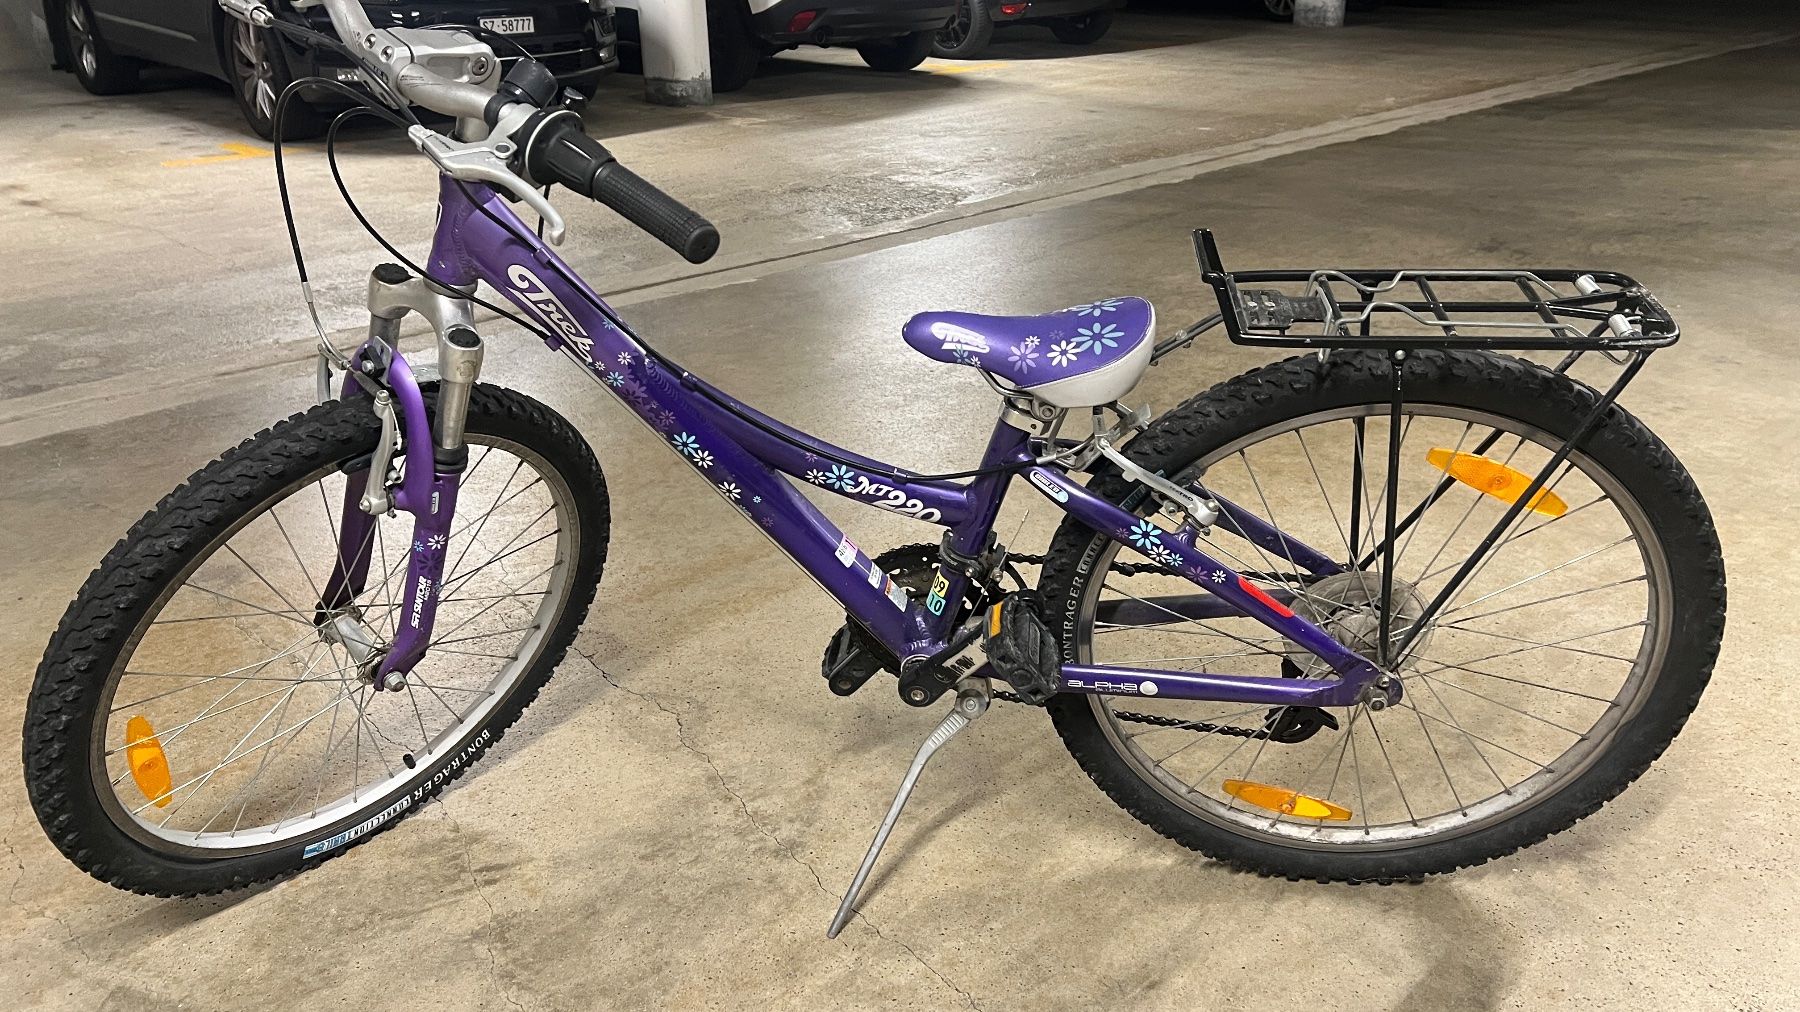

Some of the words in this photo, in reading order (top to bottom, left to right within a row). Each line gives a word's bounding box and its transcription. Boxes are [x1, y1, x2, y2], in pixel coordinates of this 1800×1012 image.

[507, 264, 595, 363] Trek
[414, 575, 427, 614] SUNTOUR
[929, 593, 944, 613] 10
[933, 575, 946, 593] 09
[413, 728, 491, 801] BONTRAGER
